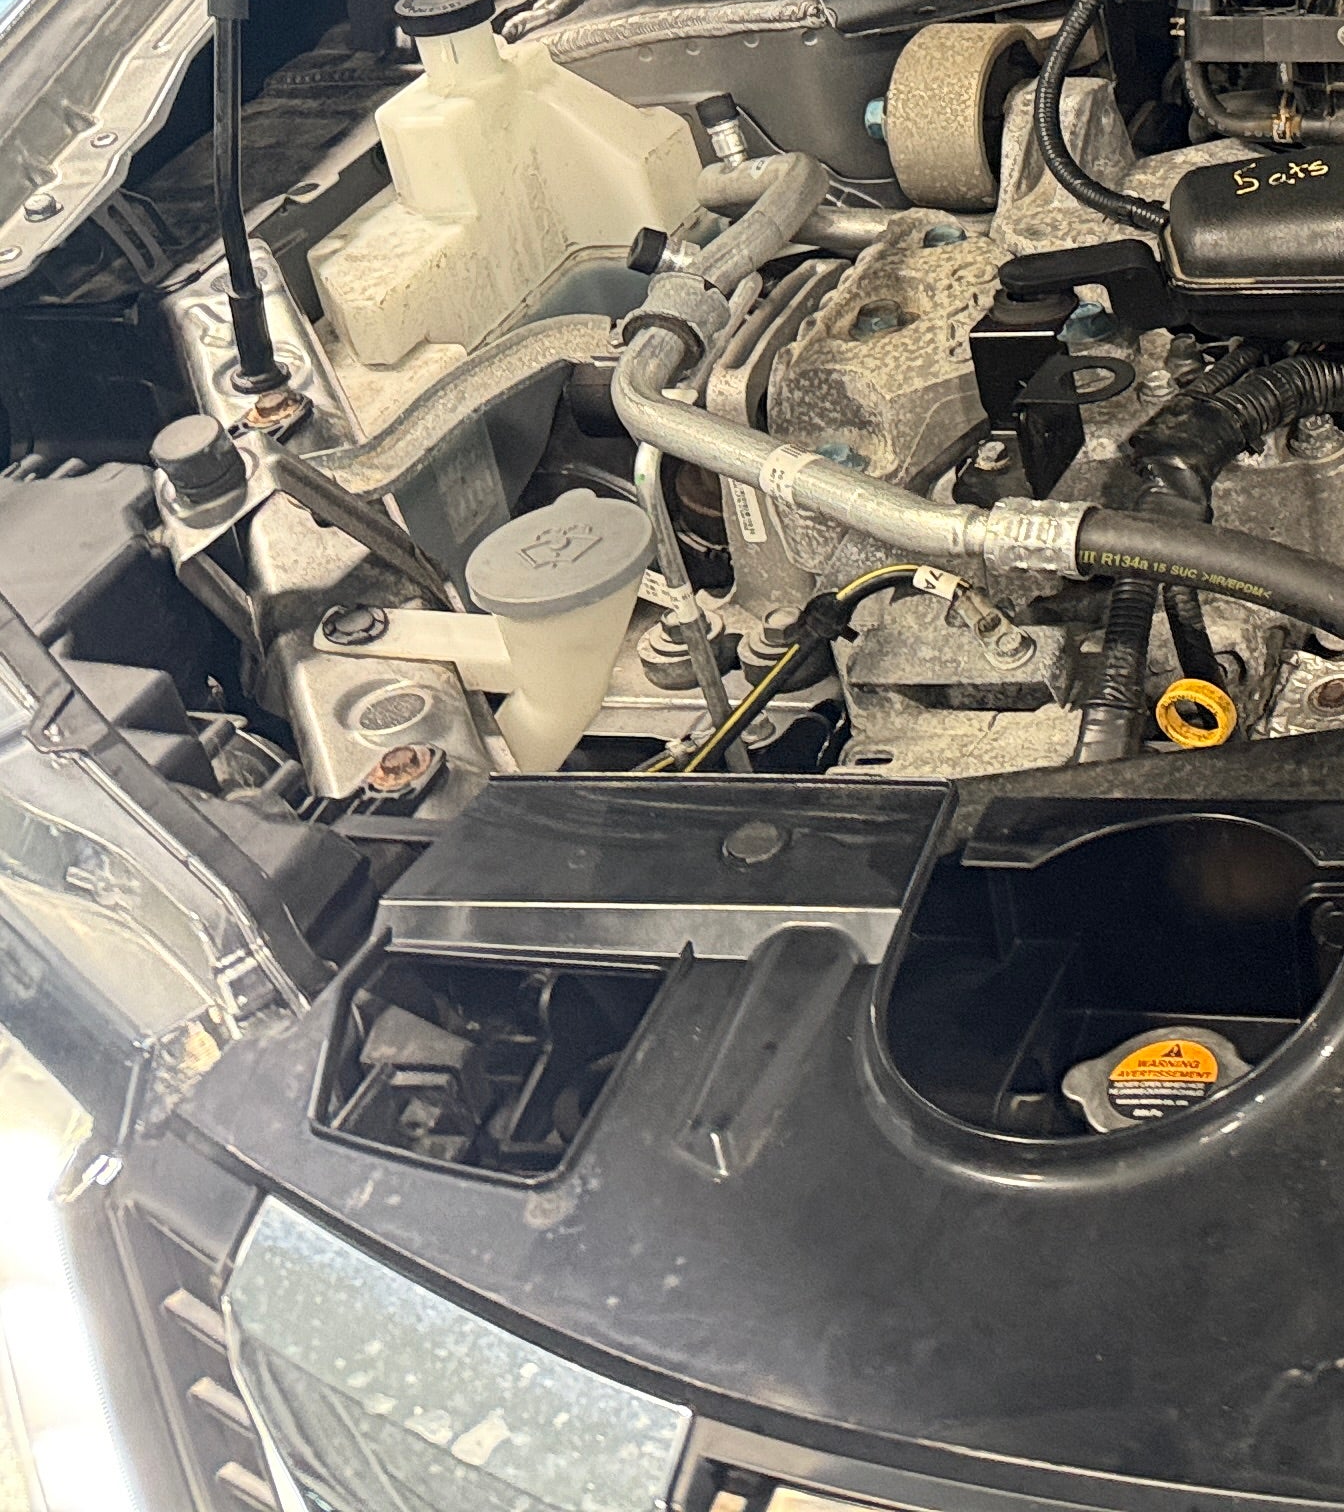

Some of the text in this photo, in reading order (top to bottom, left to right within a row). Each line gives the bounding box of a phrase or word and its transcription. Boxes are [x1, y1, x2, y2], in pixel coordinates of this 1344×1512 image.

[1232, 162, 1260, 195] 5
[1170, 564, 1198, 582] SUC
[1137, 1059, 1201, 1069] WARNING
[1117, 1070, 1213, 1079] AVERTISSEMENT
